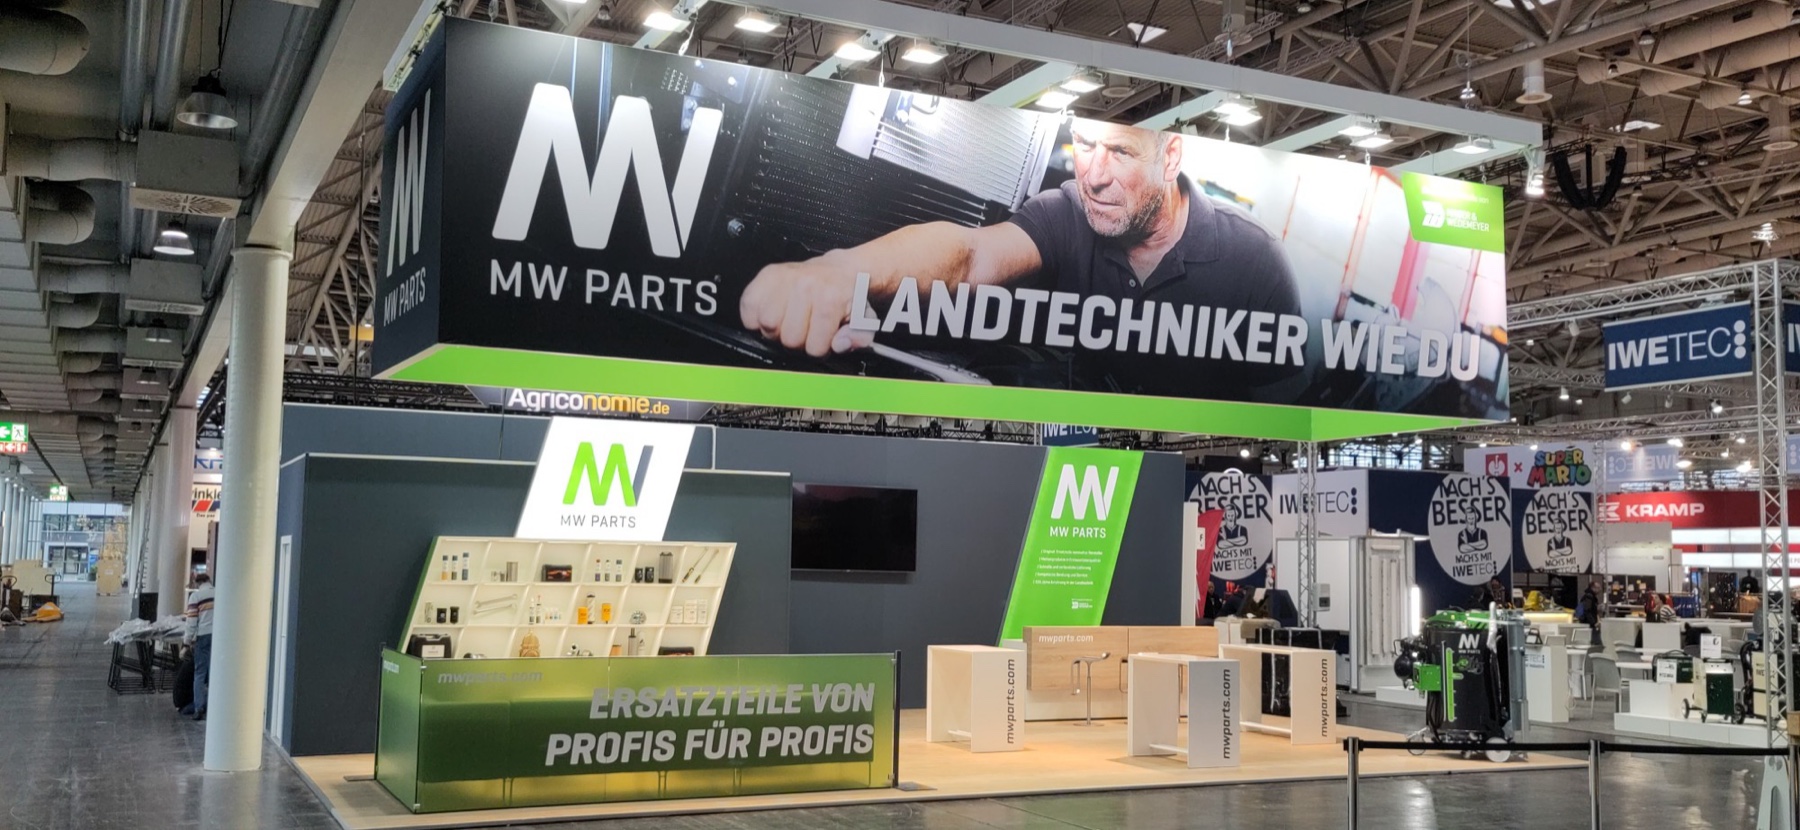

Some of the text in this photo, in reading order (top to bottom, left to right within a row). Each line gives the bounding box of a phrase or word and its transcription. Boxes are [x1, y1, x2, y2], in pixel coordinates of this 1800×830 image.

[1447, 219, 1490, 232] EDEMEYER
[384, 266, 426, 327] MW PARTS
[490, 259, 717, 316] MW PARTS
[849, 272, 1481, 382] LANDTECHNIKER WIE DU
[508, 388, 670, 414] Agriconomie.de
[1534, 448, 1584, 467] SUPER
[1527, 464, 1592, 488] MARIO
[560, 514, 636, 528] MW PARTS
[1432, 496, 1510, 527] BESSER
[1626, 502, 1705, 518] KRAMP
[1050, 526, 1106, 539] MW PARTS
[1526, 509, 1592, 537] BESSER
[1240, 547, 1253, 558] MIT
[1480, 552, 1493, 561] MIT
[1566, 557, 1577, 565] MIT
[1038, 632, 1094, 644] mwparts.com
[438, 671, 544, 685] mwparts.com
[589, 682, 875, 720] ERSATZTEILE VON
[1006, 658, 1016, 744] mwparts.com
[1222, 668, 1231, 759] mwparts.com
[545, 720, 875, 766] PROFIS FÜR PROFIS
